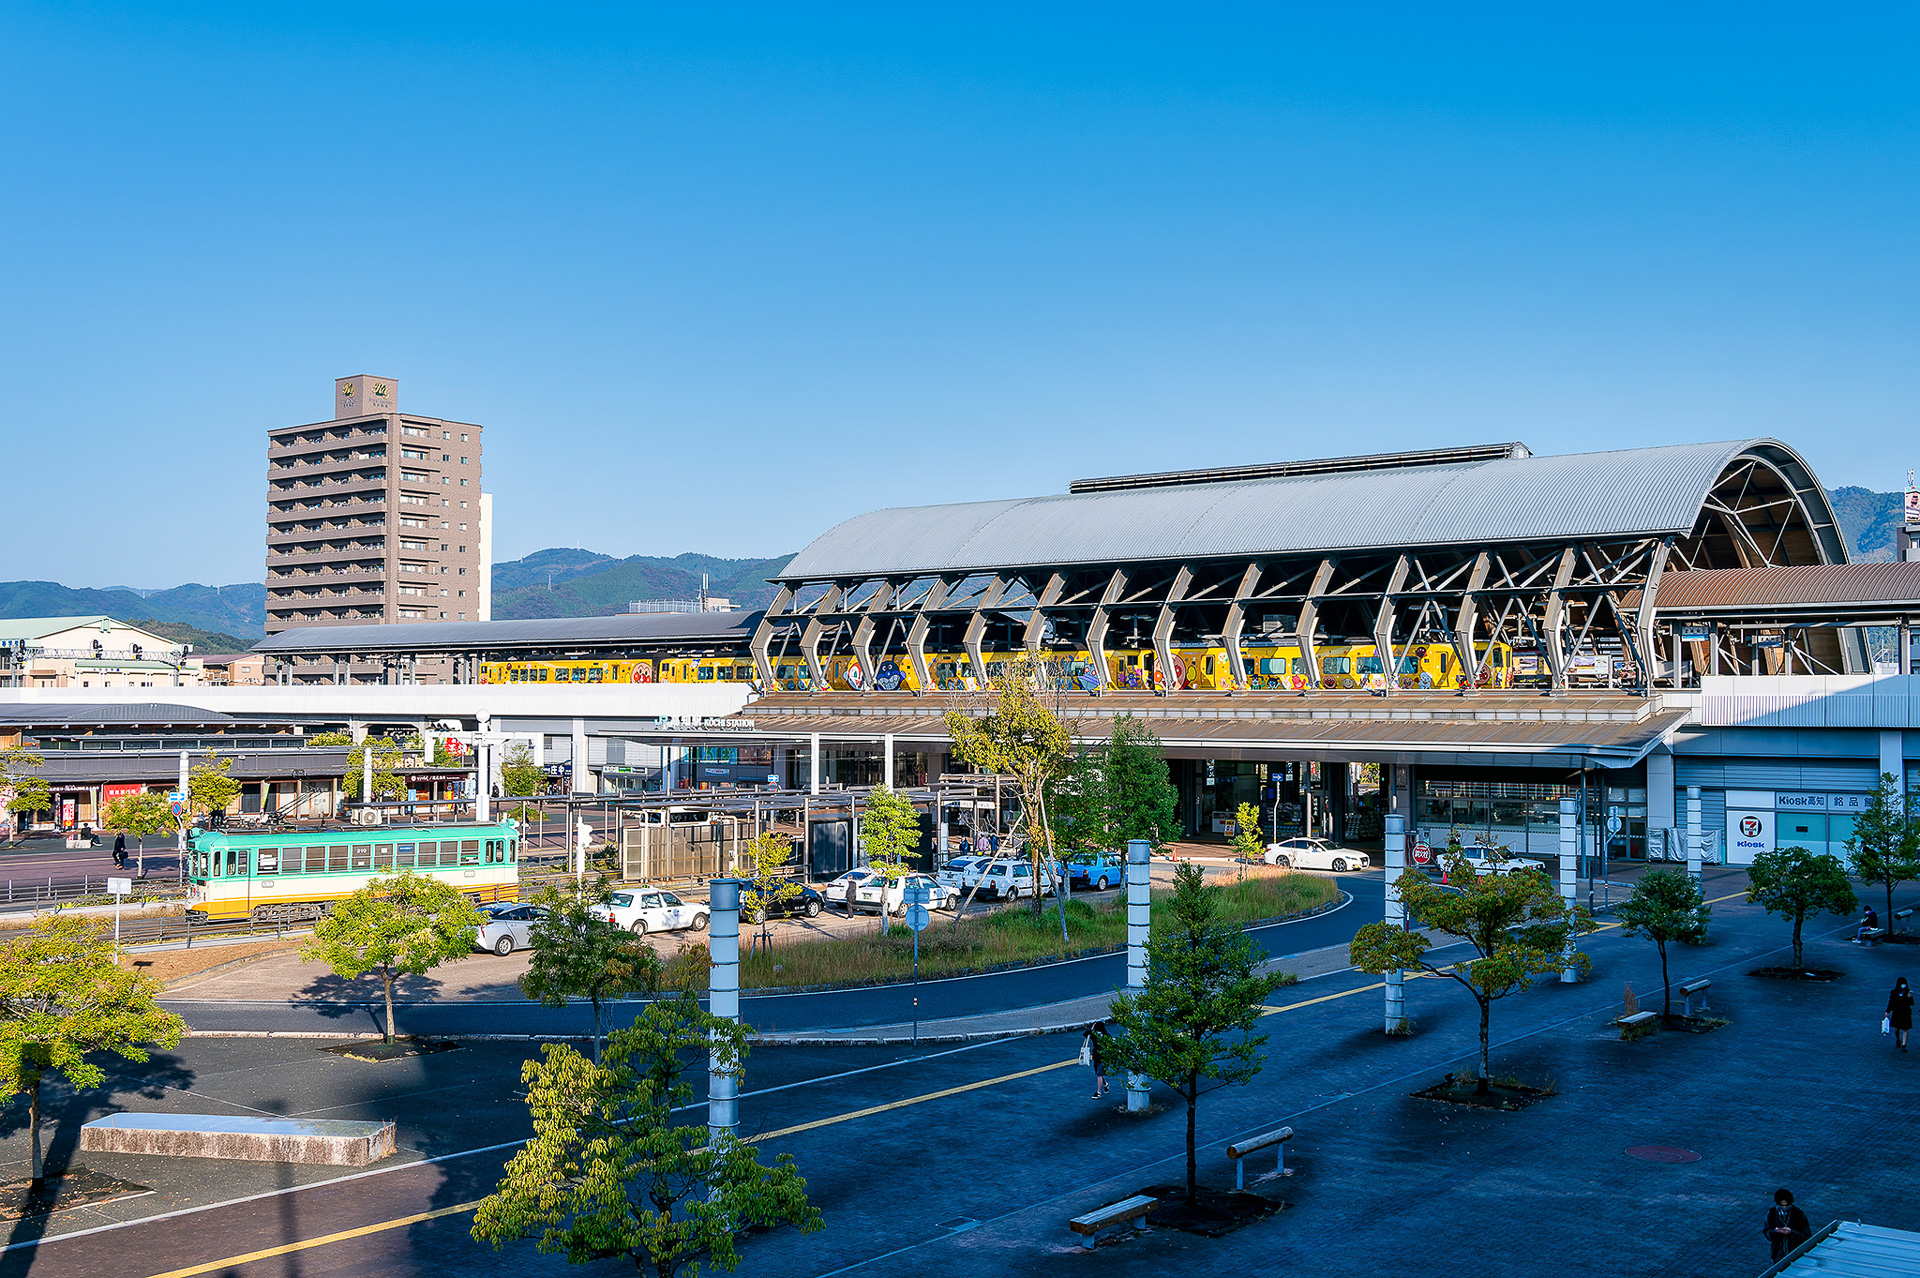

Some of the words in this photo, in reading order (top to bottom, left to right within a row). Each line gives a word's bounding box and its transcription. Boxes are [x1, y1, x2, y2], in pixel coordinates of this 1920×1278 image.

[654, 715, 668, 727] JR
[726, 718, 755, 727] STATION
[1778, 795, 1825, 806] Kiosk高知
[1736, 841, 1765, 849] Kiosk
